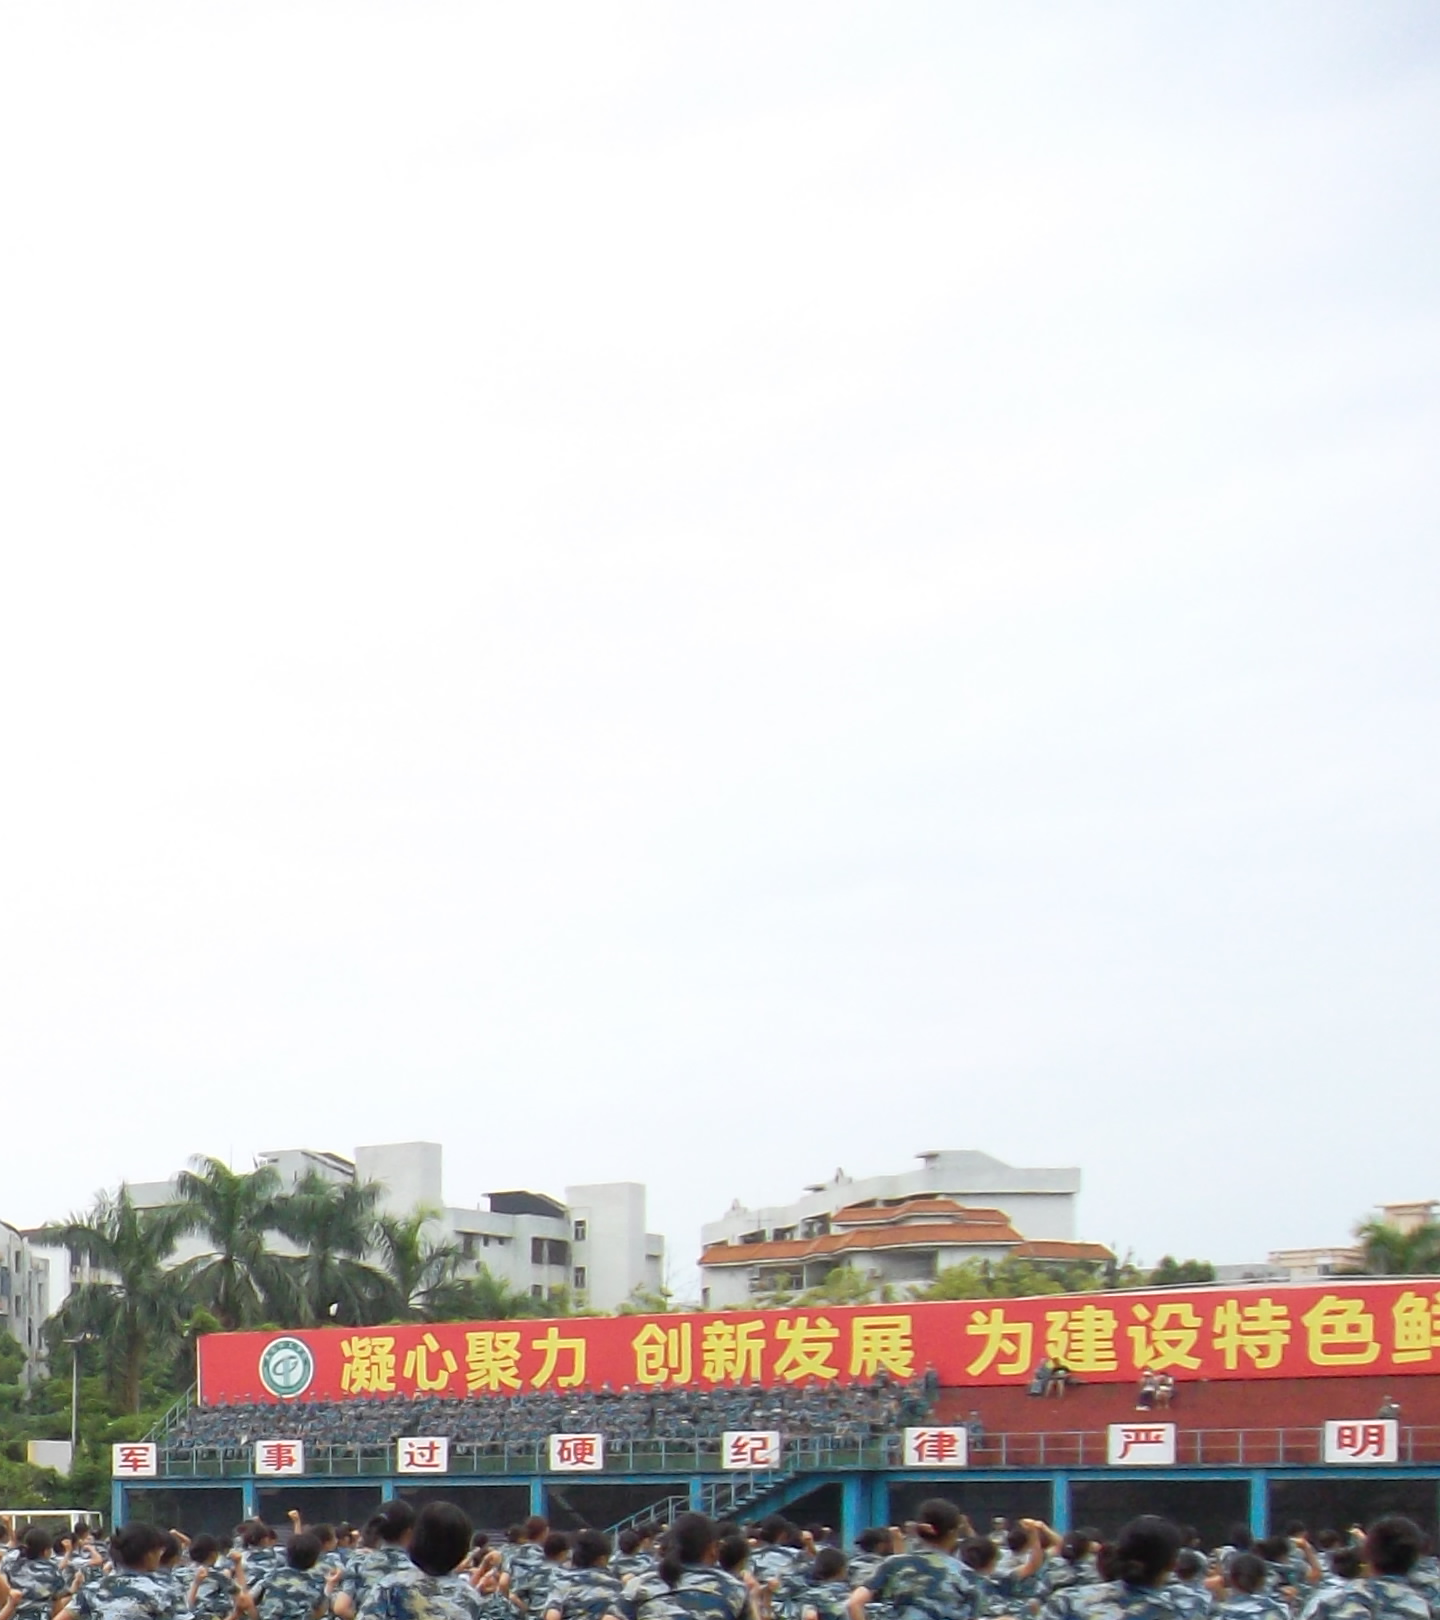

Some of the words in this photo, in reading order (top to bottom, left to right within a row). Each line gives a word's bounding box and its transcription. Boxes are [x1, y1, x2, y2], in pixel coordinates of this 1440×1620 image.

[340, 1327, 587, 1394] 凝心聚力
[631, 1315, 915, 1385] 创新发展
[119, 1447, 151, 1472] 军
[261, 1443, 297, 1471] 事
[403, 1441, 442, 1468] 过
[555, 1438, 596, 1466] 硬
[730, 1436, 772, 1465] 纪
[912, 1430, 961, 1462] 律
[1116, 1426, 1168, 1460] 严
[1334, 1423, 1387, 1457] 明
